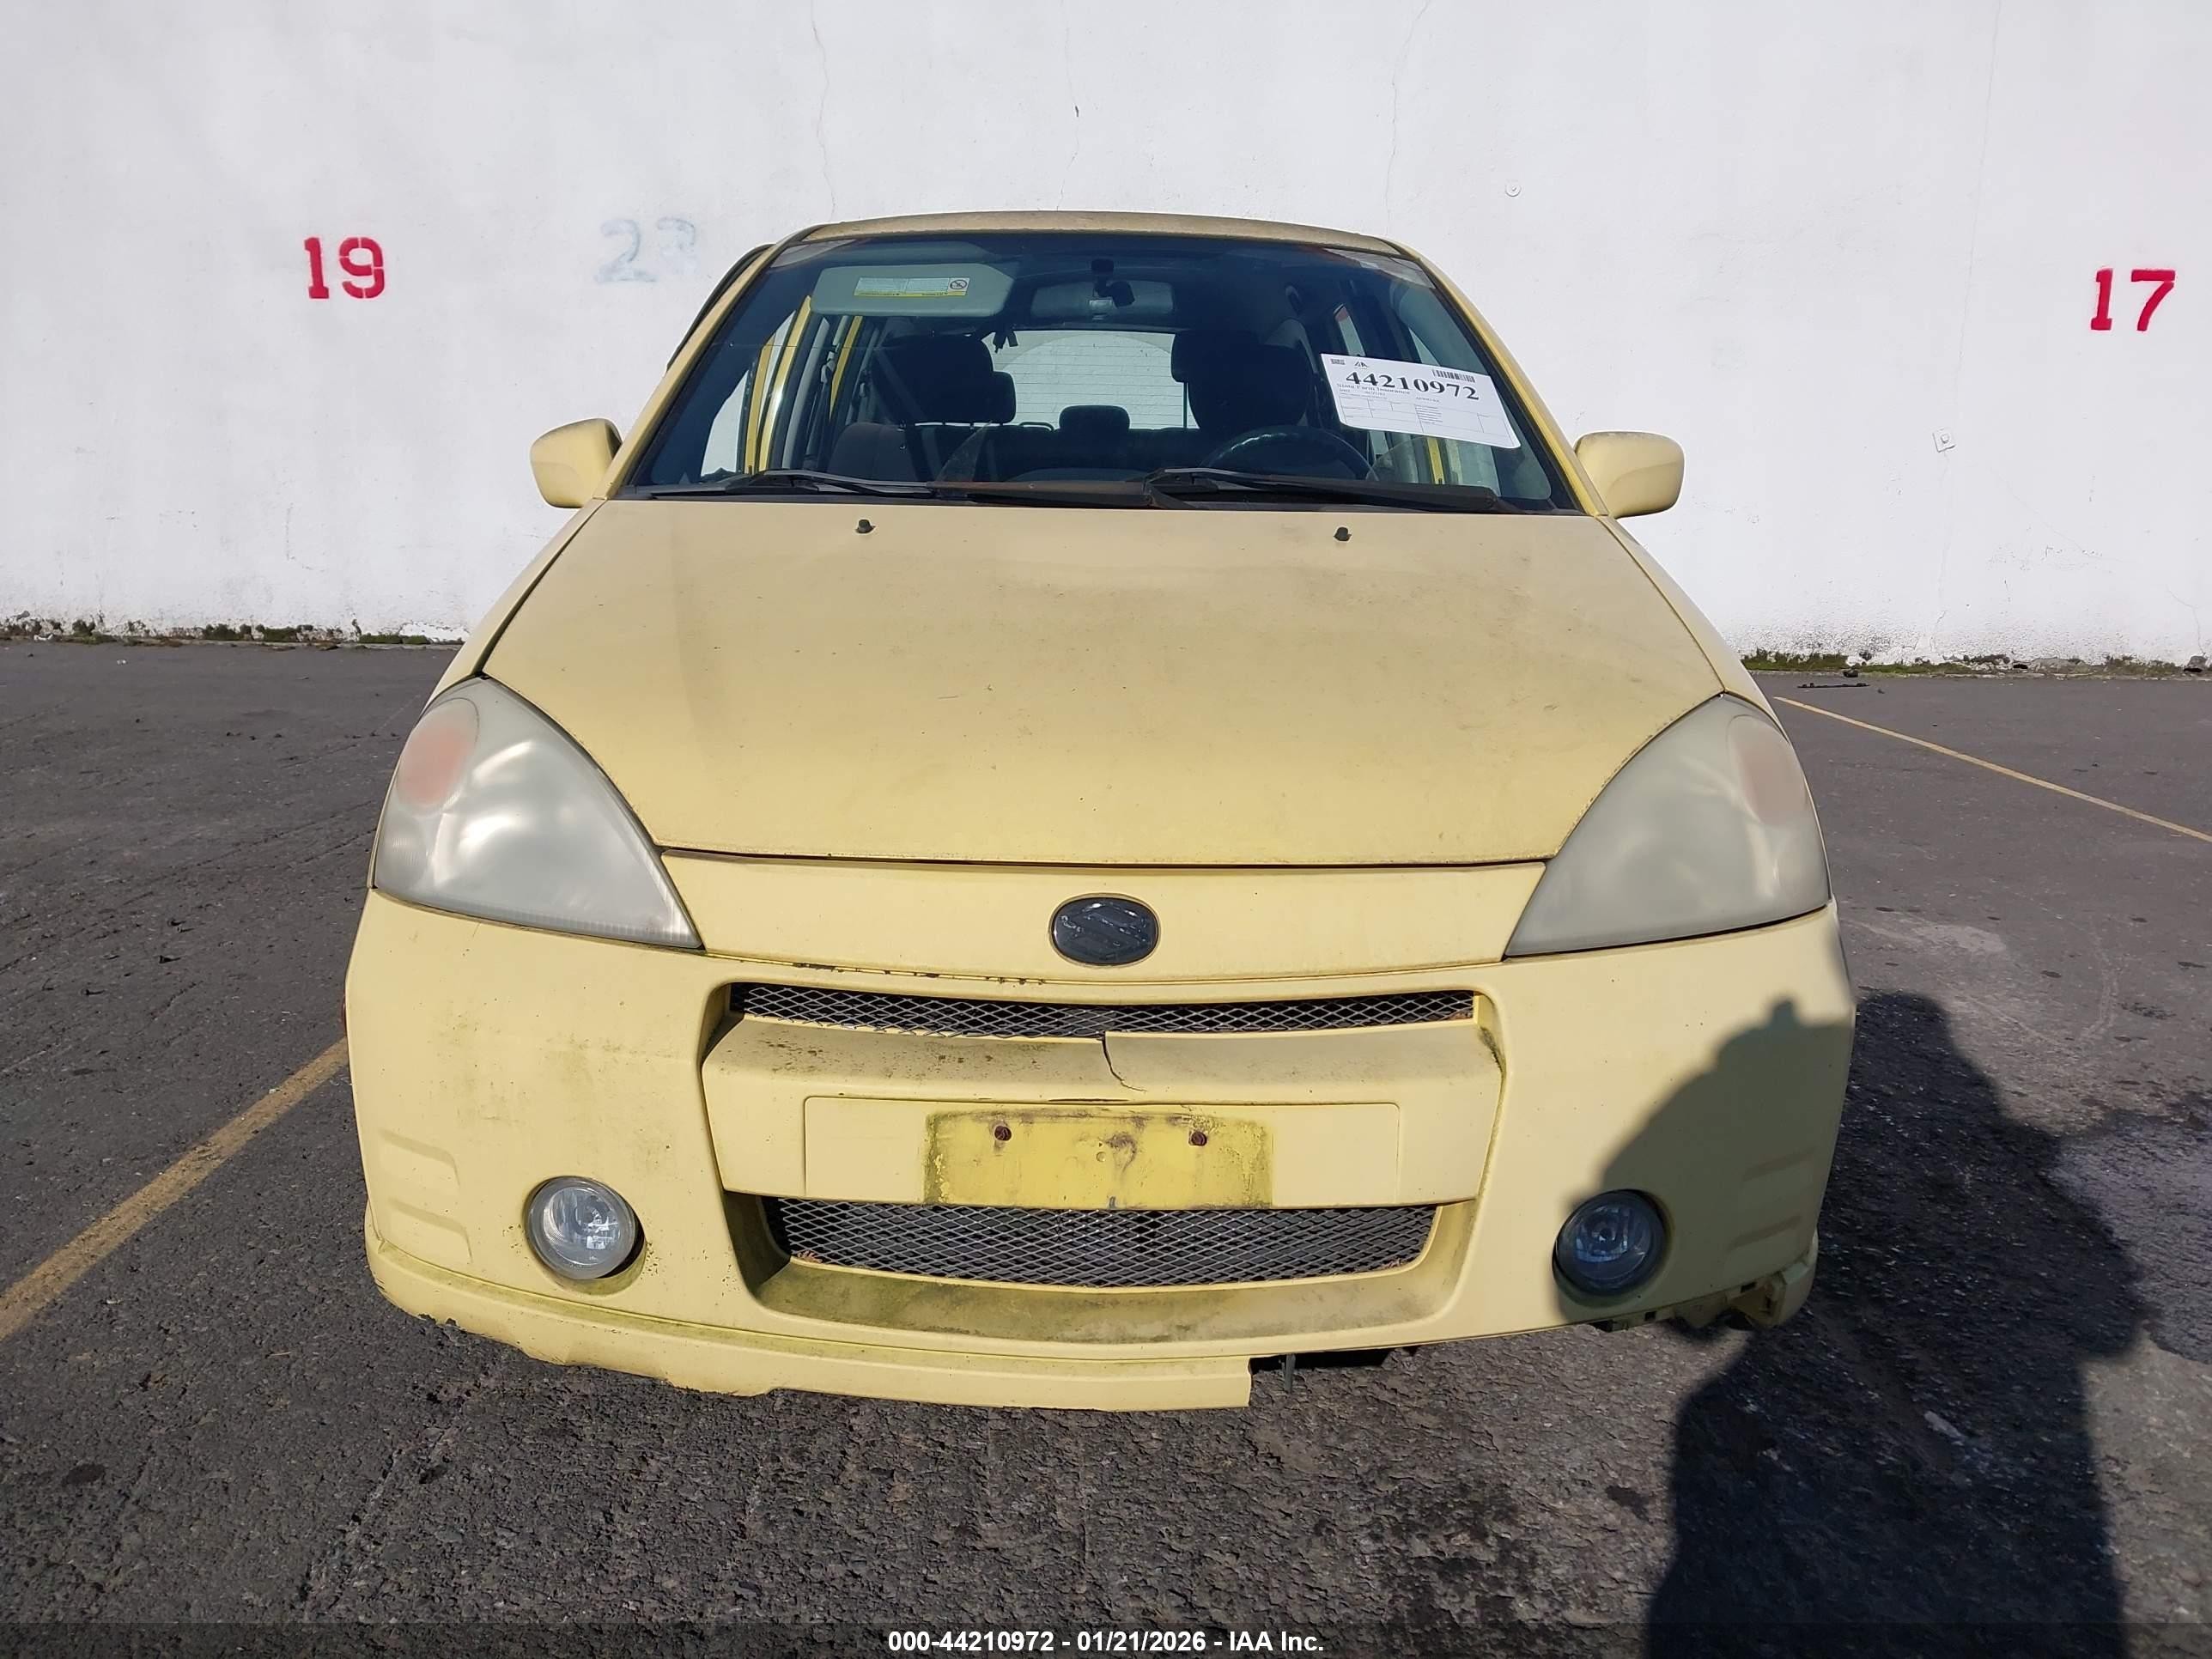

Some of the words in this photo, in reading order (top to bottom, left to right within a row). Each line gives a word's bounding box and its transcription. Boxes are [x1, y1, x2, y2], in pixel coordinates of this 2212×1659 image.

[305, 237, 386, 300] 19
[2090, 268, 2176, 331] 17
[1346, 372, 1480, 400] 44210972
